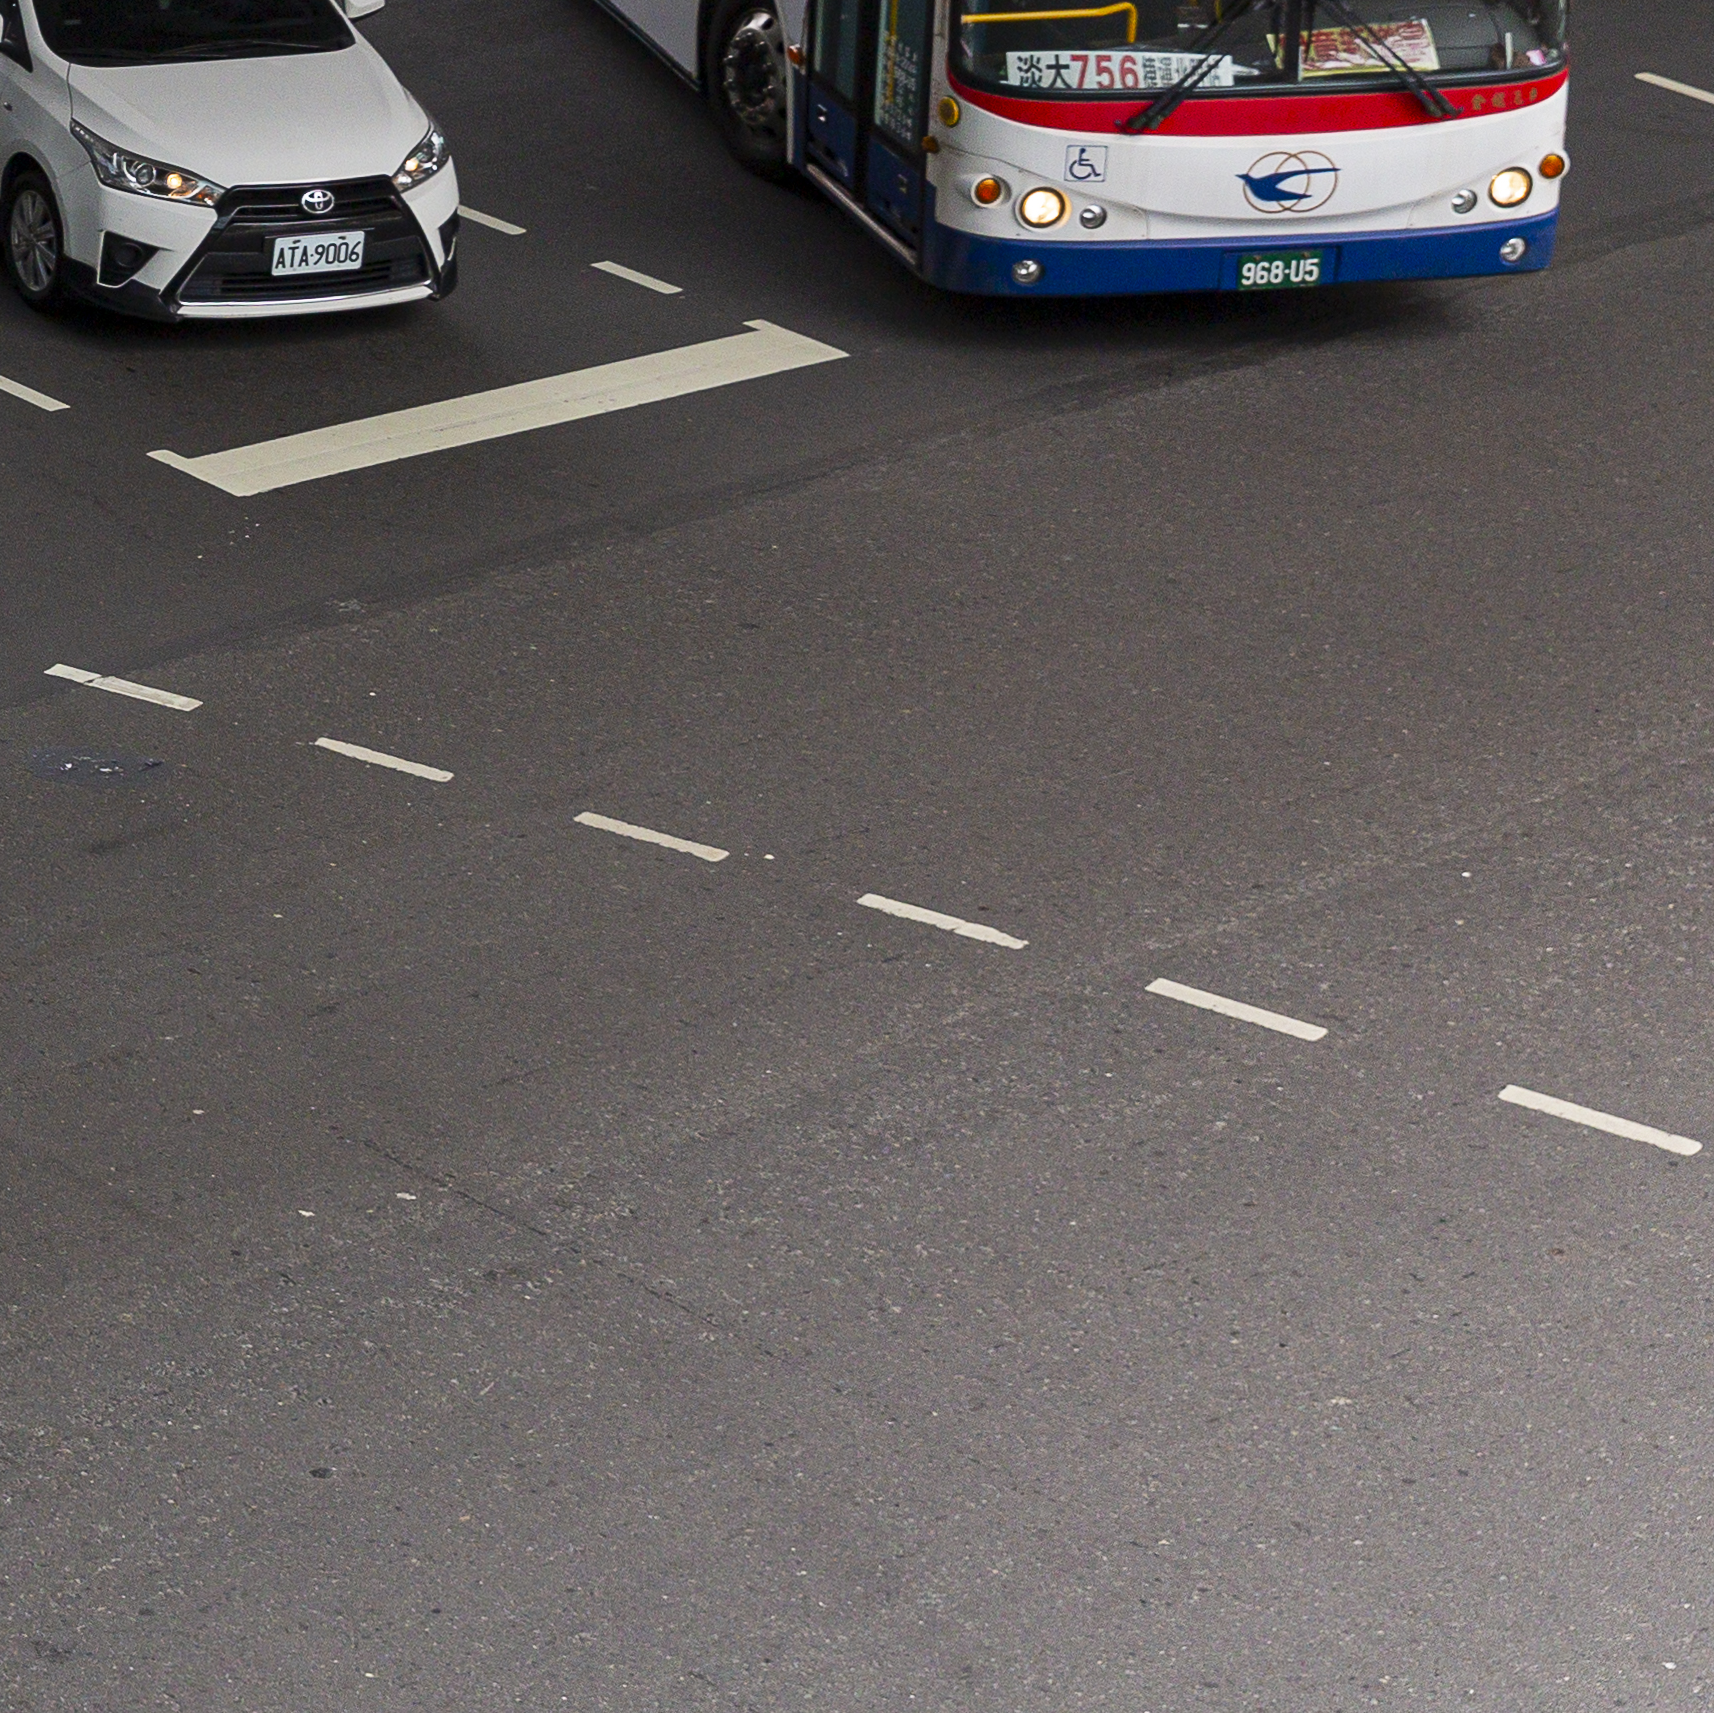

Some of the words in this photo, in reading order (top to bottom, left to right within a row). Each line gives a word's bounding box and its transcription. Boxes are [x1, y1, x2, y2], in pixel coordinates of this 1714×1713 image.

[1070, 54, 1140, 89] 756
[275, 241, 361, 269] ATA-9006
[1241, 258, 1320, 285] 968-U5
